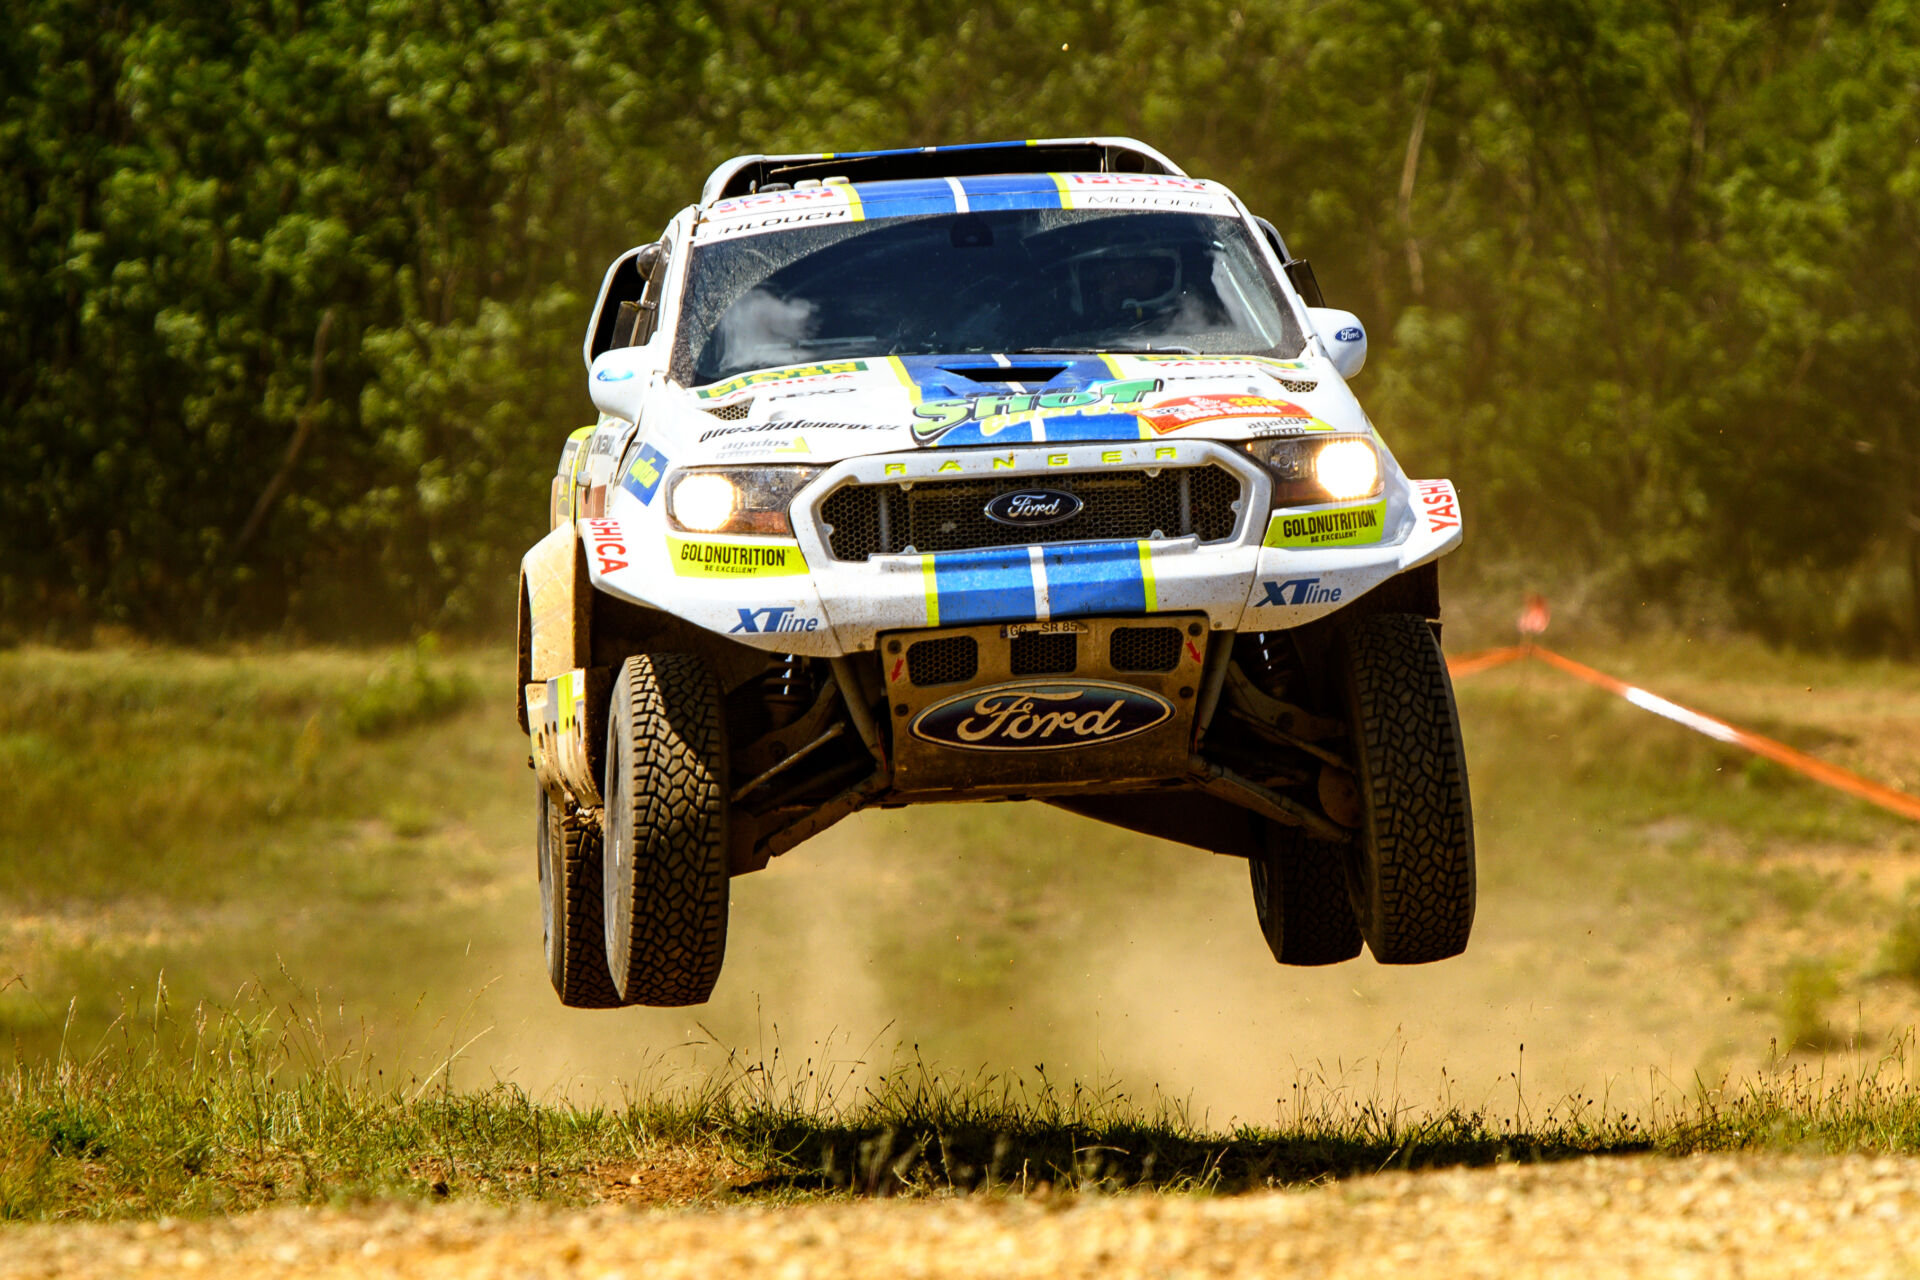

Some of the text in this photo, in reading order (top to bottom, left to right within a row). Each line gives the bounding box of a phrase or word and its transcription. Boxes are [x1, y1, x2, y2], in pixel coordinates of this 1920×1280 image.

[910, 378, 1164, 447] SHOT
[884, 447, 1179, 477] RANGER
[1007, 493, 1060, 518] Ford
[1283, 509, 1377, 538] GOLDNUTRITION
[1310, 530, 1358, 543] BE EXCELLENT
[589, 518, 629, 575] SHICA
[681, 543, 786, 567] GOLDNUTRITION
[704, 564, 758, 575] BE EXCELLENT
[1254, 578, 1342, 607] XTline
[728, 607, 819, 634] XTline
[1062, 621, 1078, 632] 85
[956, 690, 1126, 742] Ford
